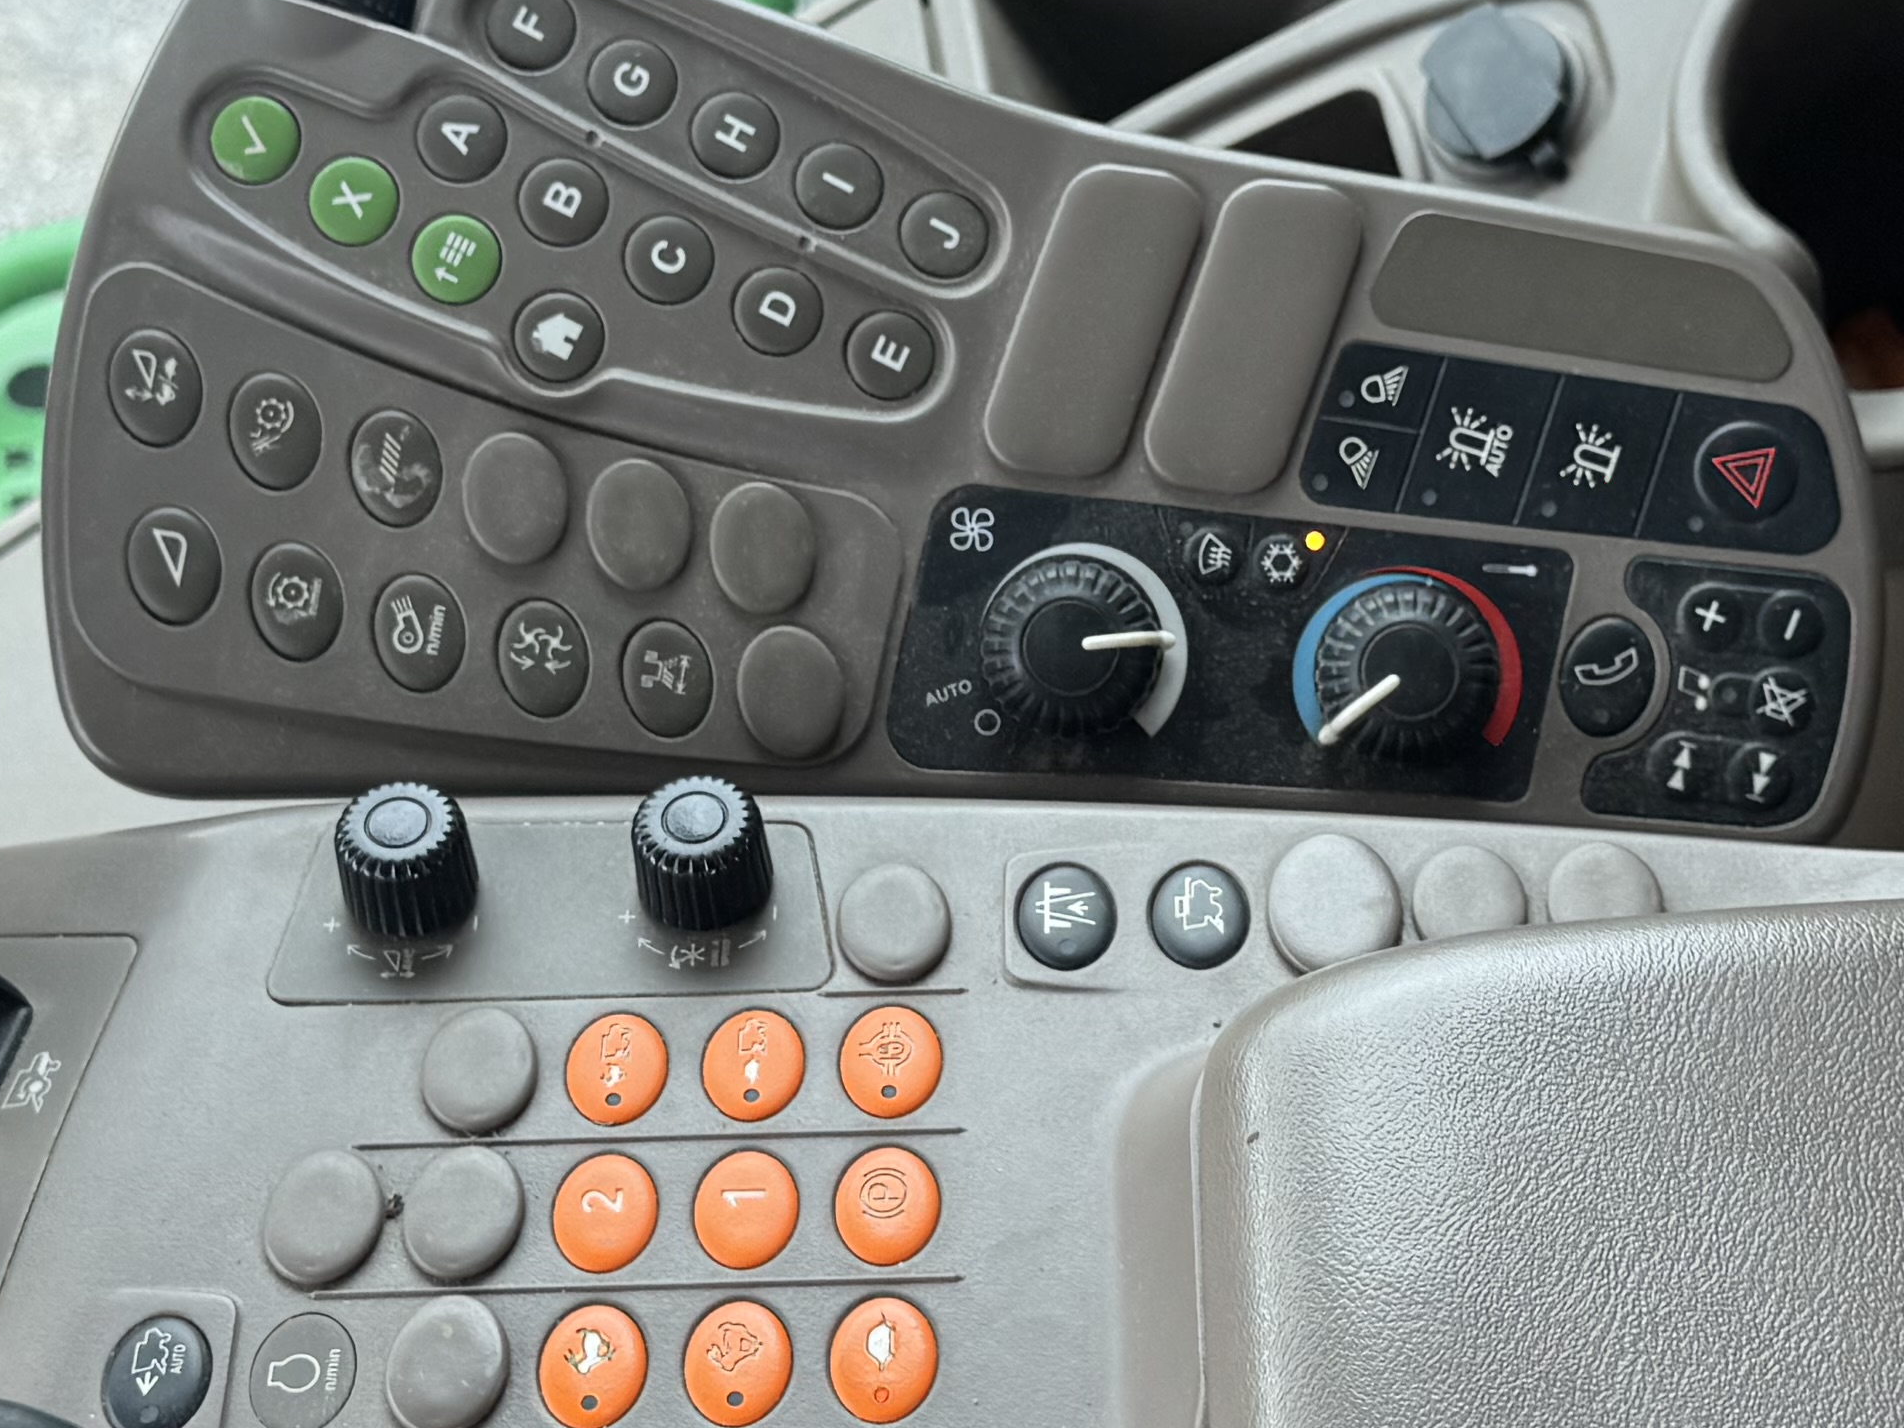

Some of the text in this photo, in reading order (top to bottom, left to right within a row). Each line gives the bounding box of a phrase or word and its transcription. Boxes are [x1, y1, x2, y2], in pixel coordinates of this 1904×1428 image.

[512, 5, 545, 42] F
[613, 62, 650, 97] G
[440, 122, 480, 156] A
[714, 112, 756, 153] H
[541, 182, 582, 218] B
[822, 172, 855, 194] I
[929, 217, 960, 250] J
[650, 239, 686, 274] C
[758, 290, 796, 327] D
[870, 334, 912, 373] E
[1484, 423, 1514, 479] AUTO
[425, 603, 447, 657] n/min
[925, 678, 973, 708] AUTO
[580, 1187, 624, 1213] 2
[720, 1188, 767, 1208] 1
[170, 1343, 187, 1375] AUTO
[325, 1347, 342, 1392] n/min
